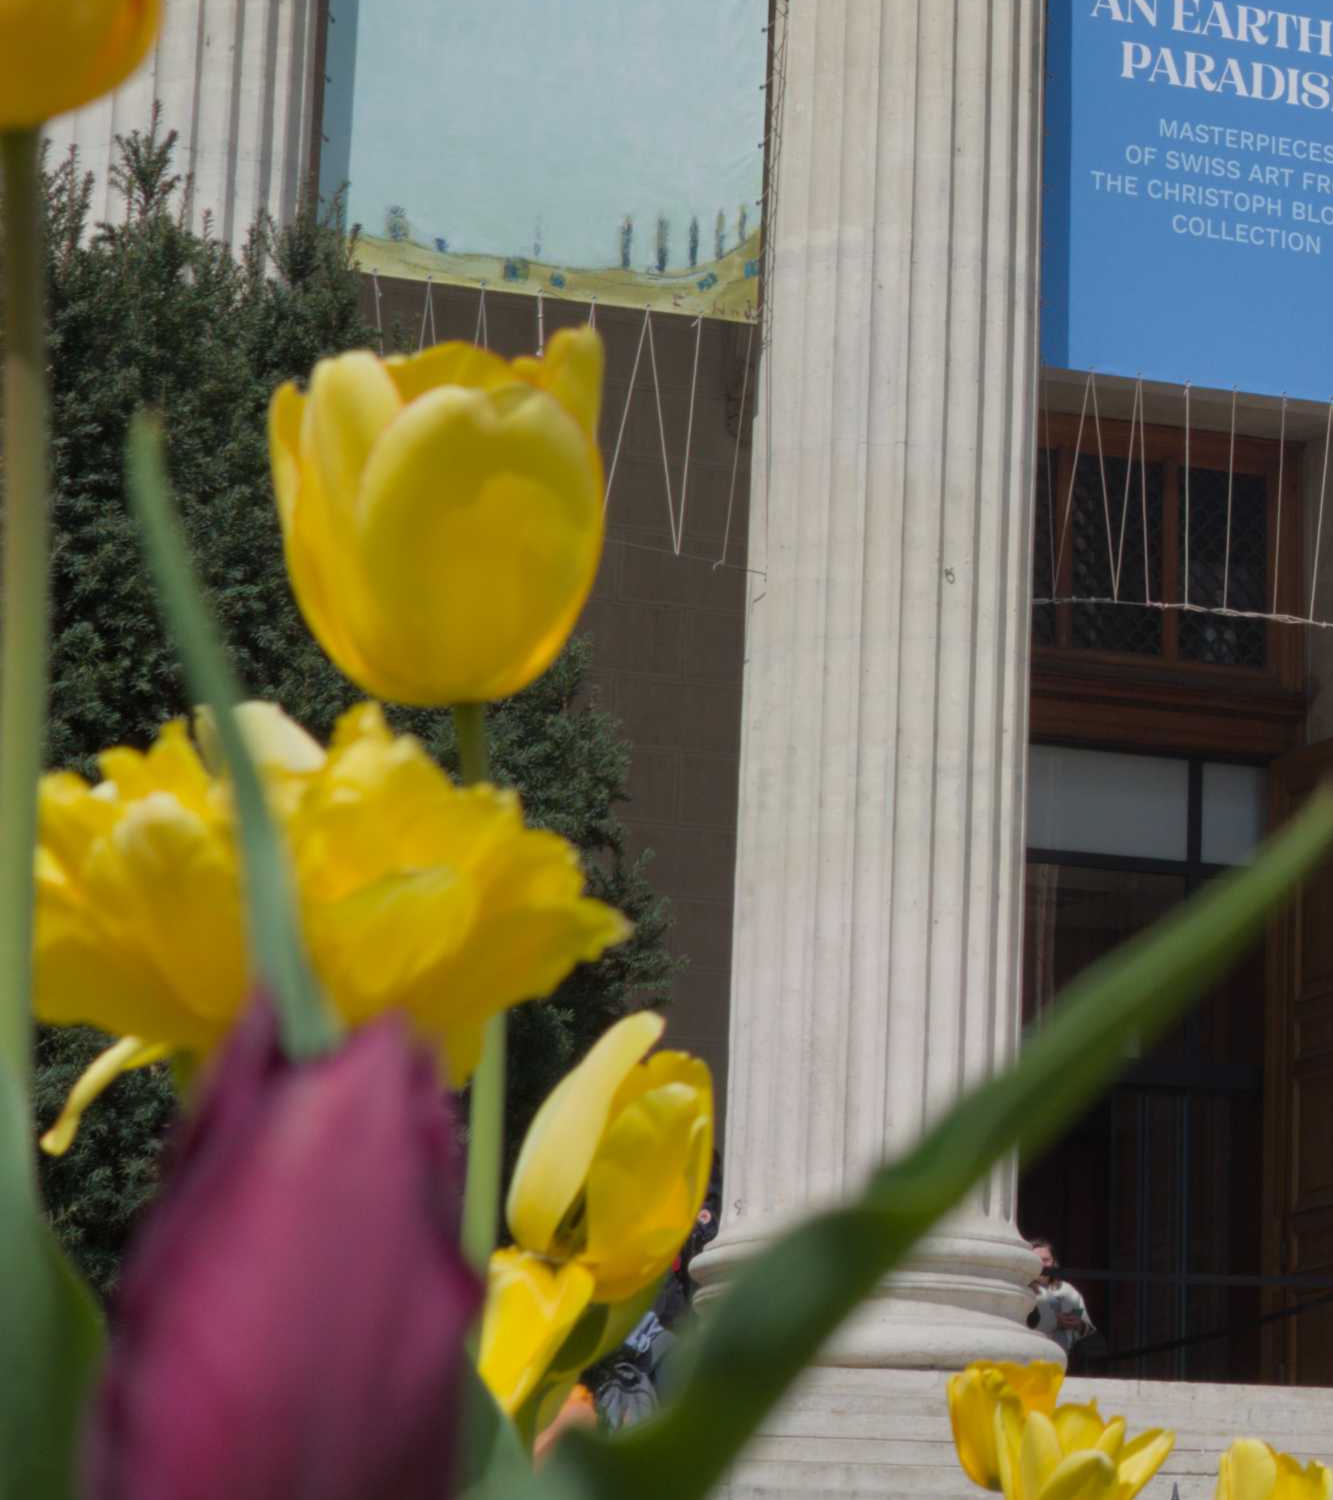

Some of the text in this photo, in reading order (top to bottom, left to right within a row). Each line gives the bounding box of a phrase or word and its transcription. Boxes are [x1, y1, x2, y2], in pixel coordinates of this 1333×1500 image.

[1125, 144, 1157, 166] OF
[1166, 151, 1241, 180] SWISS
[1248, 165, 1293, 189] ART
[1090, 170, 1138, 196] THE
[1147, 179, 1282, 217] CHRISTOPH
[1172, 214, 1321, 255] COLLECTION
